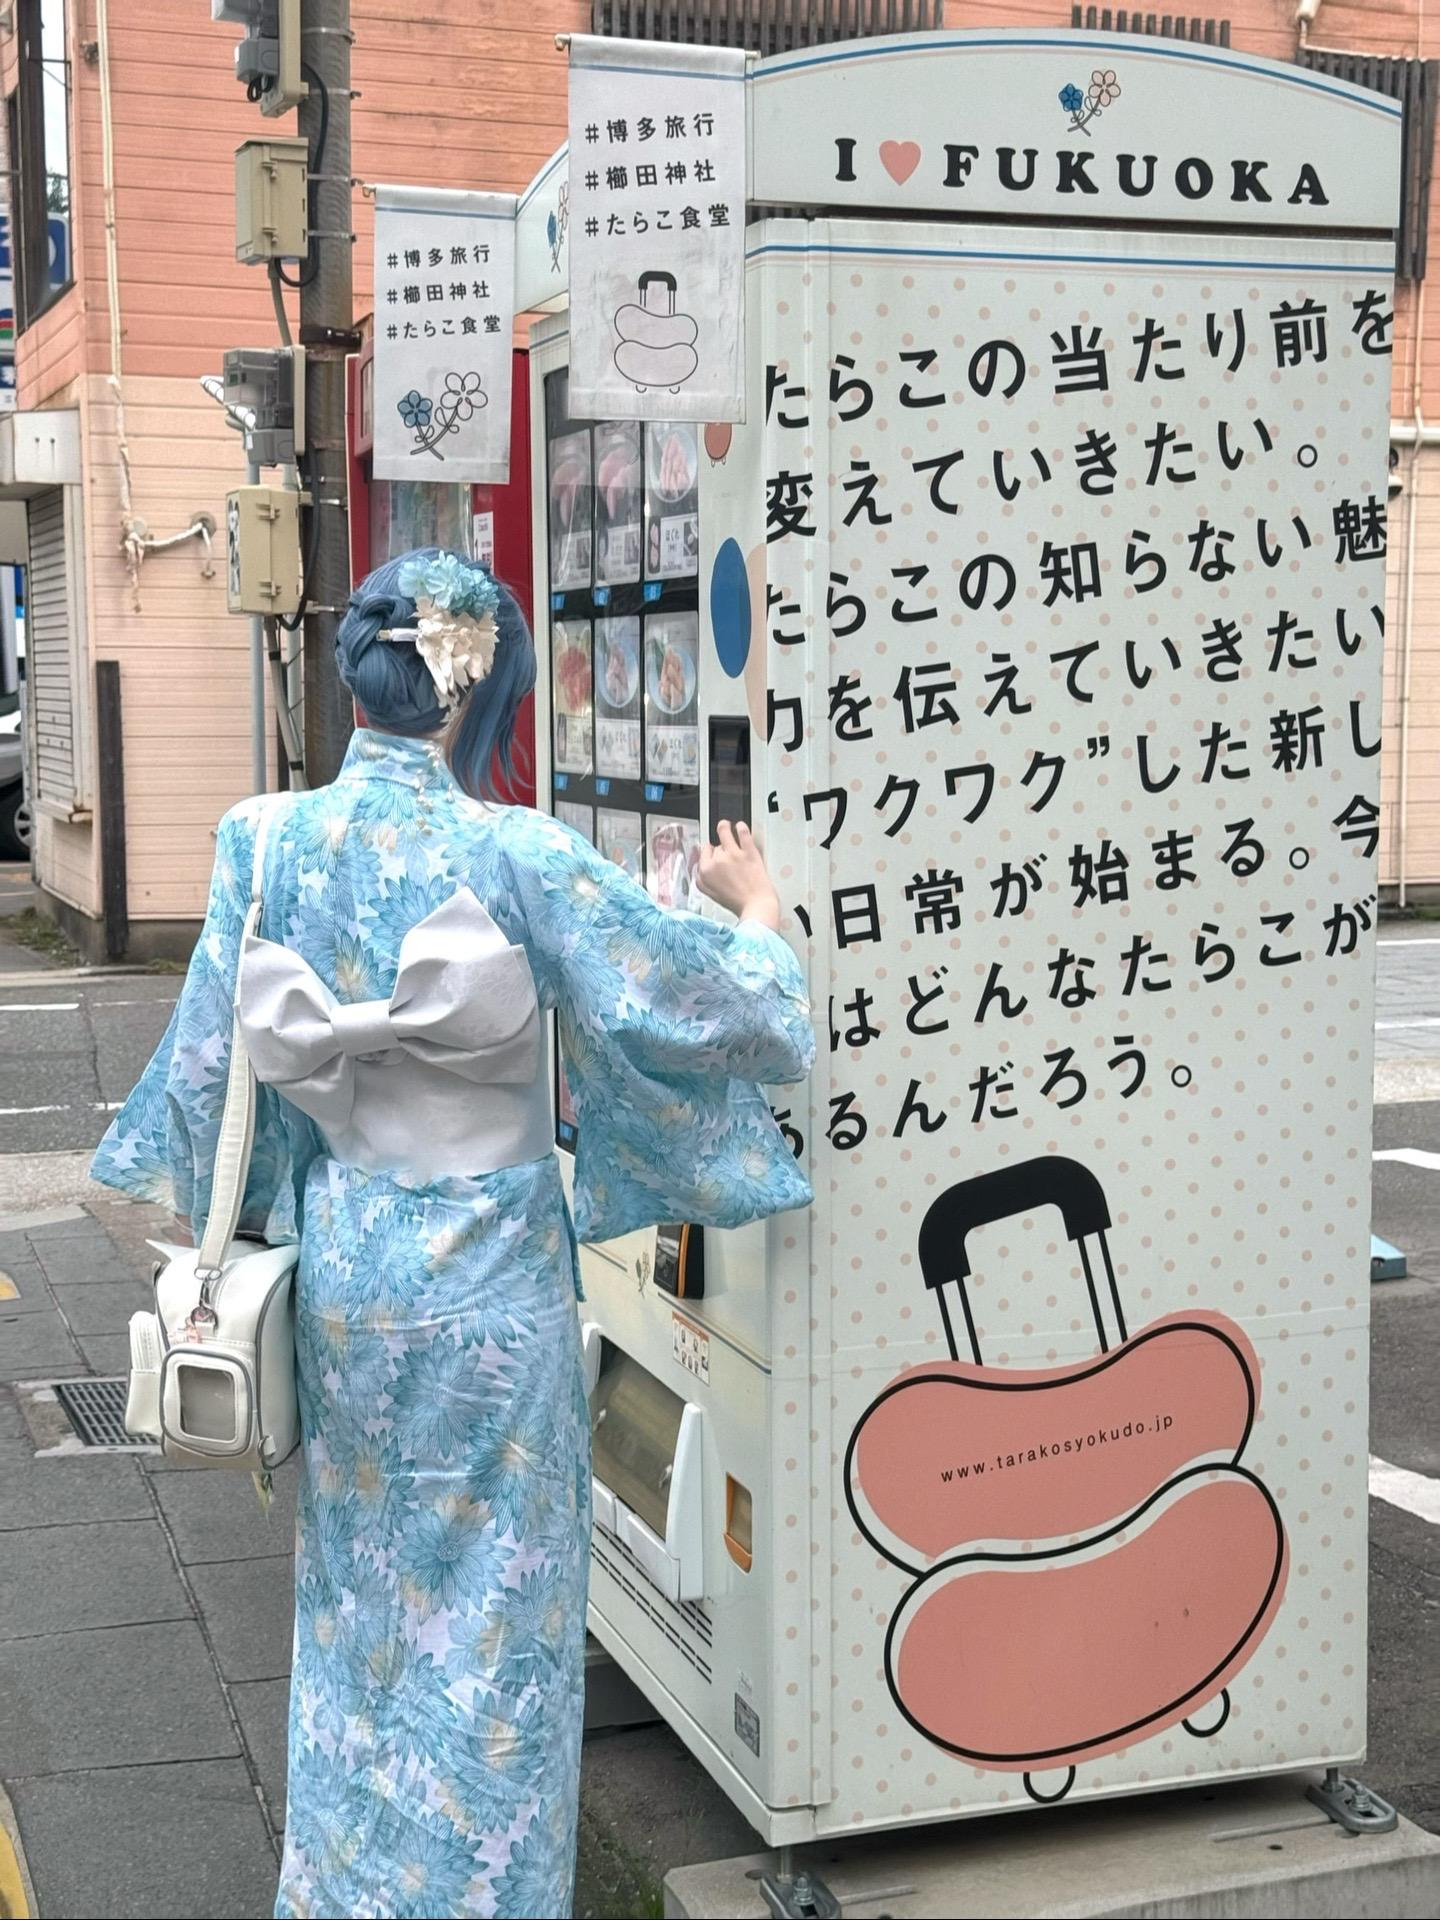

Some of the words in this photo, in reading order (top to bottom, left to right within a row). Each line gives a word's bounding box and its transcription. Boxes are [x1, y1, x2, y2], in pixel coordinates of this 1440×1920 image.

[585, 112, 715, 144] #博多旅行
[585, 159, 716, 191] #櫛田神社
[834, 138, 858, 182] I
[942, 144, 1330, 206] FUKUOKA
[585, 203, 731, 237] #たらこ食堂
[387, 244, 491, 269] #博多旅行
[387, 280, 491, 304] #櫛田神社
[387, 314, 502, 340] #たらこ食堂
[766, 289, 1394, 429] たらこの当たり前を
[766, 417, 1318, 544] 変えていきたい。
[766, 495, 1387, 646] たらこの知らない魅
[766, 604, 1385, 752] 力を伝えていきたい
[941, 1413, 1173, 1482] www.tarakosyokudo.jp
